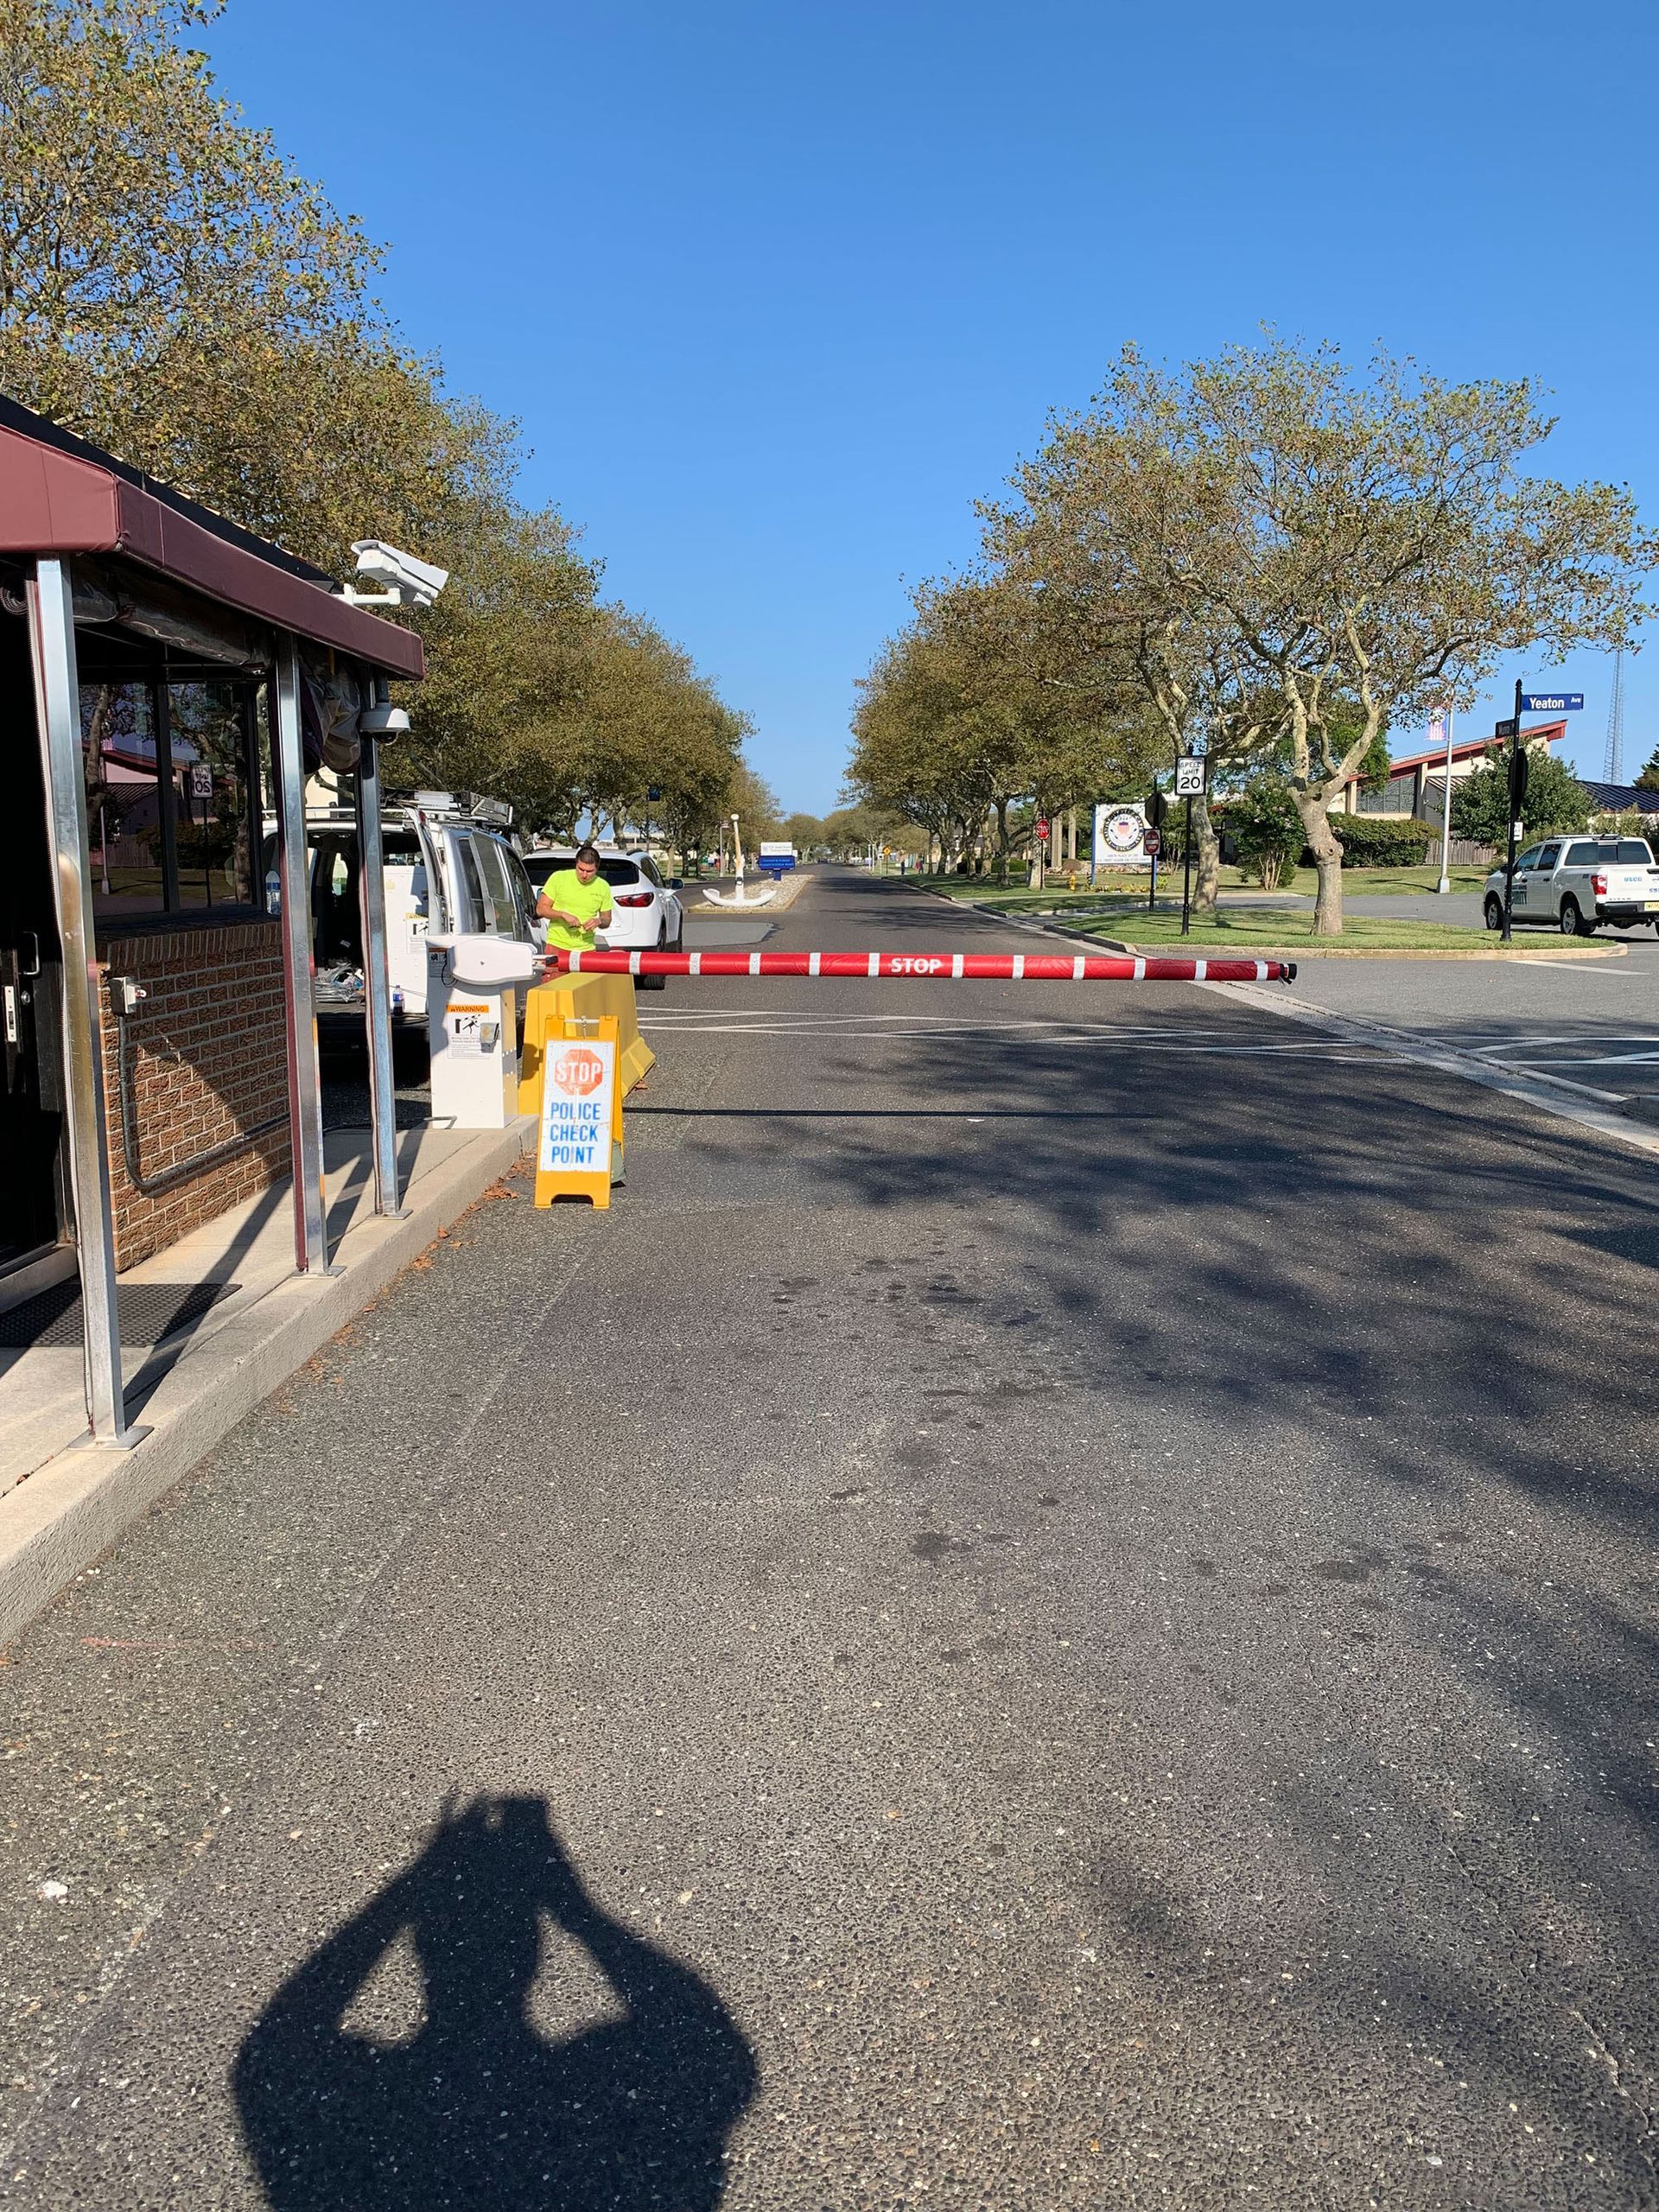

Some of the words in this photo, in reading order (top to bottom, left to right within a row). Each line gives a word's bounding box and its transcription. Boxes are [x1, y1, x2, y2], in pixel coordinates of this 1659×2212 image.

[1529, 697, 1565, 709] Yeaton
[1180, 776, 1201, 789] 20
[890, 957, 942, 974] STOP
[556, 1061, 602, 1084] STOP
[550, 1102, 601, 1121] POLICE
[550, 1124, 598, 1142] CHECK
[551, 1146, 594, 1165] POINT
